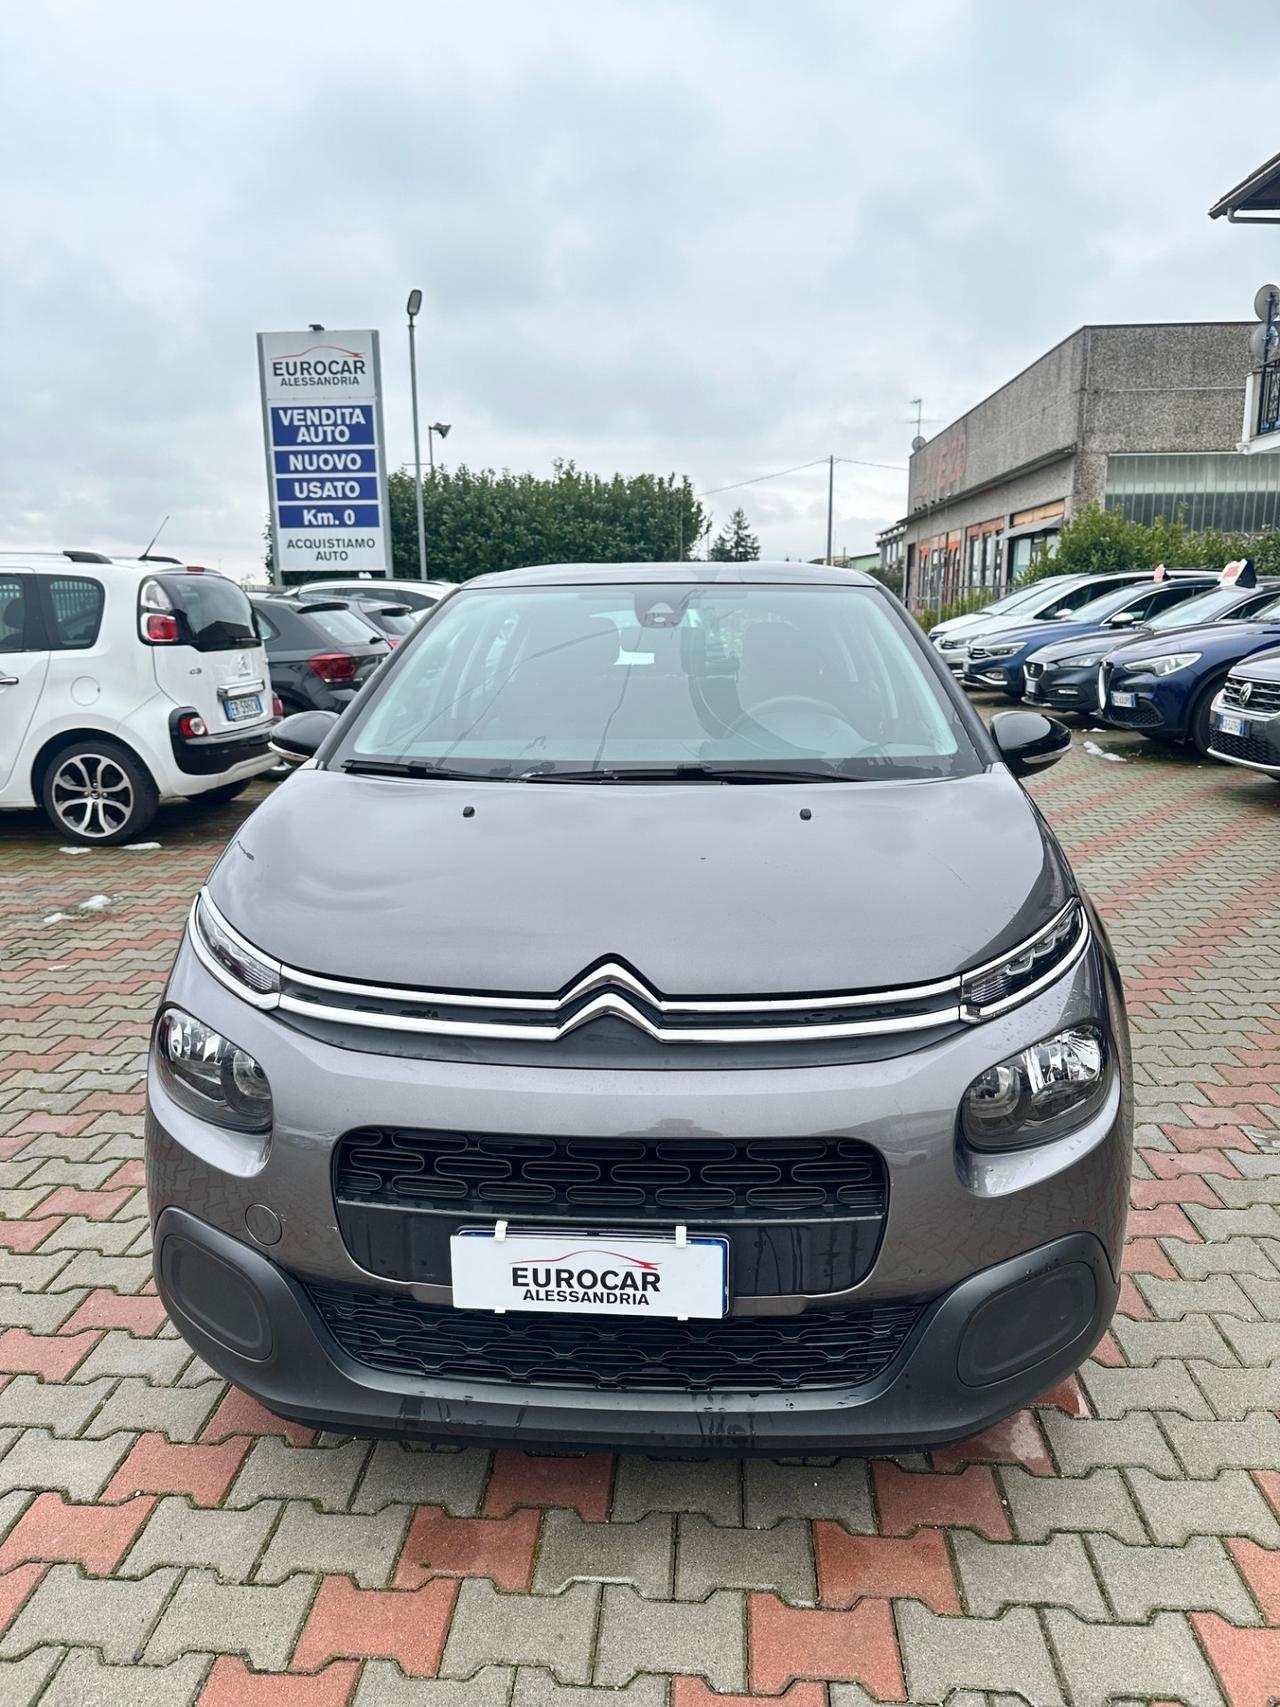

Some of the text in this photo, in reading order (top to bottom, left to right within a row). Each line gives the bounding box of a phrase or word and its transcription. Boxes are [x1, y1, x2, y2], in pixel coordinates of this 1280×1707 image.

[273, 360, 366, 376] EUROCAR
[280, 376, 360, 387] ALESSANDRIA
[278, 408, 366, 426] VENDITA
[296, 426, 350, 443] AUTO
[289, 453, 362, 472] NUOVO
[294, 481, 361, 498] USATO
[303, 509, 355, 526] Km. 0
[287, 538, 376, 549] ACQUISTIAMO
[315, 550, 349, 561] AUTO
[511, 1266, 661, 1292] EUROCAR
[522, 1289, 650, 1306] ALESSANDRIA
